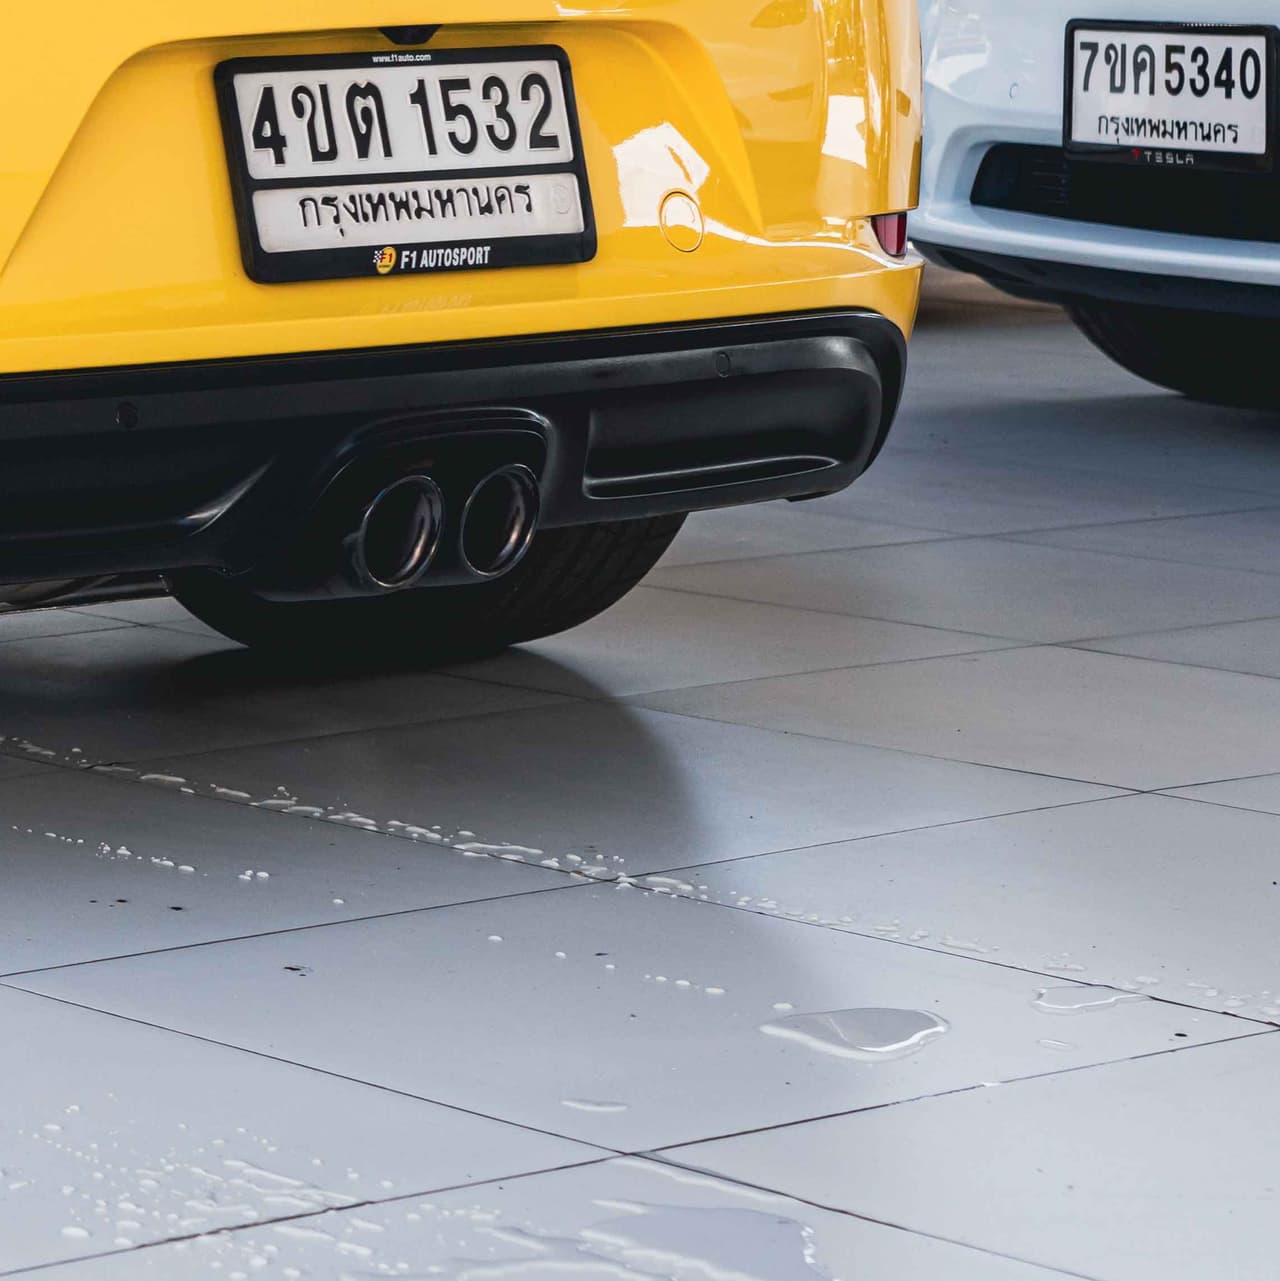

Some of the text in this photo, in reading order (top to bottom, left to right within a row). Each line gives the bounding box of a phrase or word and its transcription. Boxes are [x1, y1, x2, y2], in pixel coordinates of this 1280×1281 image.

[1079, 41, 1261, 100] 7ขค 5340
[251, 72, 561, 166] 4ขต 1532
[1097, 114, 1239, 145] กรุงเทพมหานคร
[1144, 151, 1194, 165] TESLA
[297, 183, 533, 238] กรุงเทพมหานคร
[380, 250, 393, 264] F1
[400, 245, 491, 269] F1 AUTOSPORT
